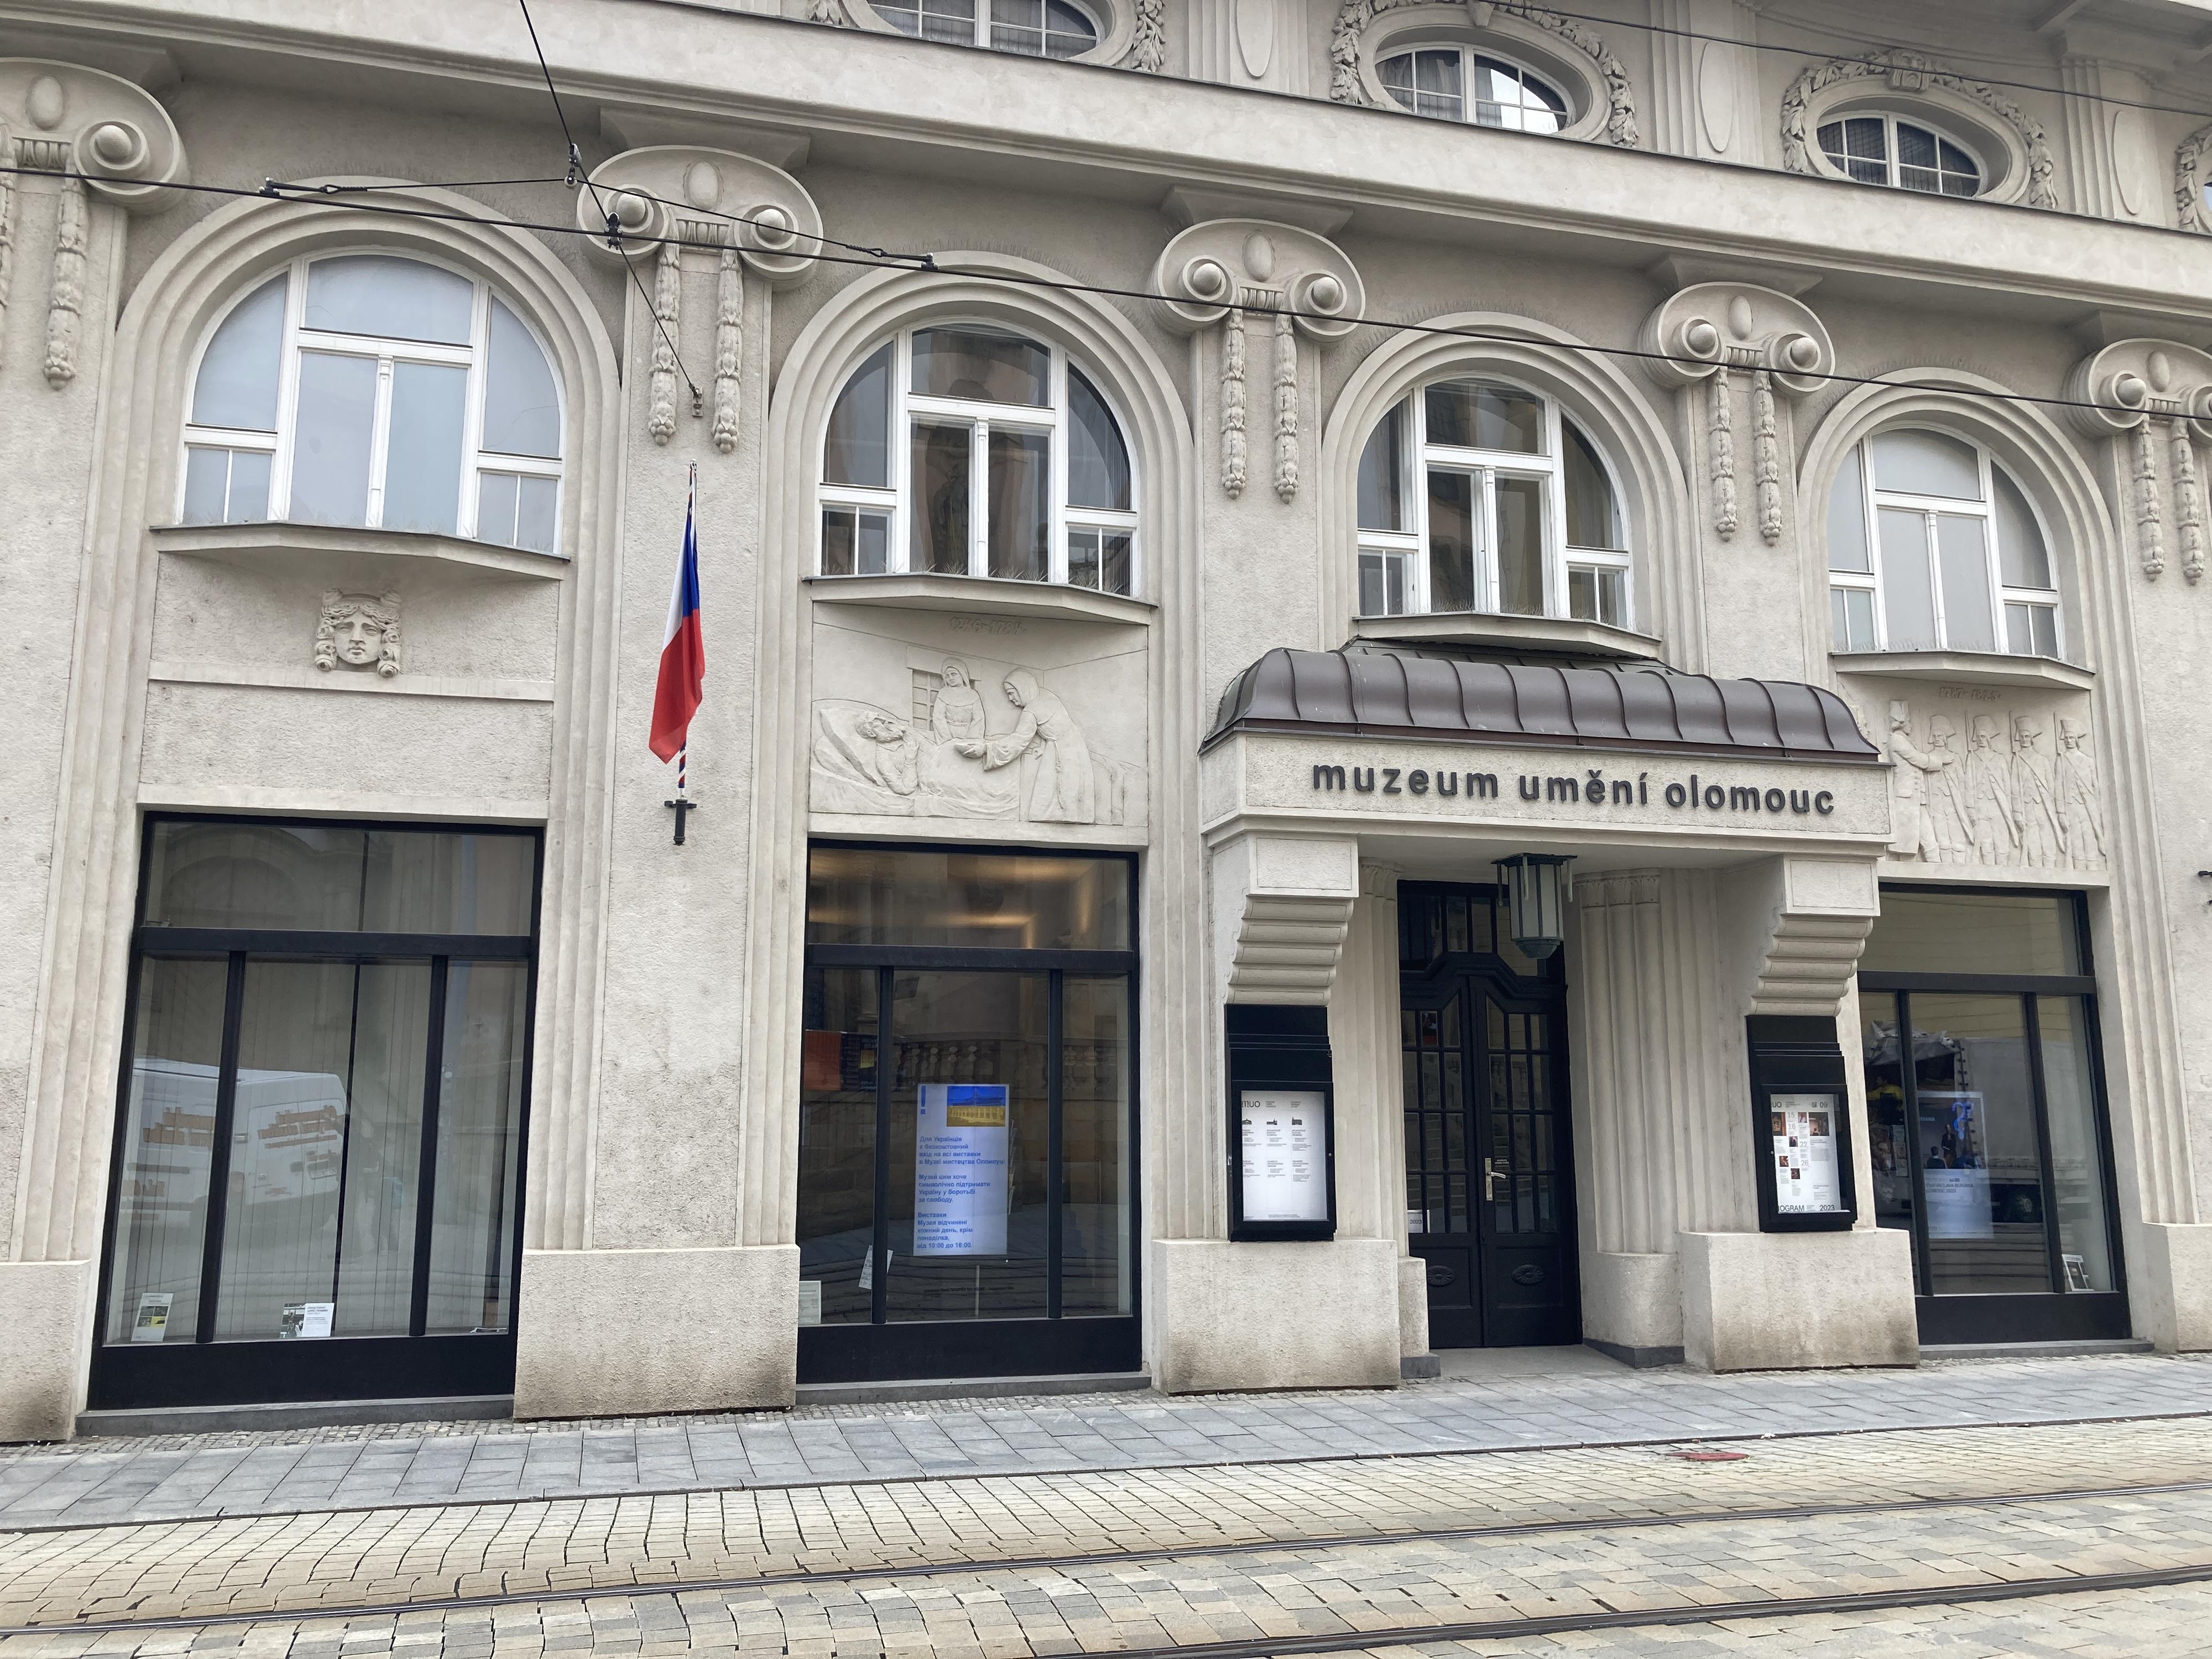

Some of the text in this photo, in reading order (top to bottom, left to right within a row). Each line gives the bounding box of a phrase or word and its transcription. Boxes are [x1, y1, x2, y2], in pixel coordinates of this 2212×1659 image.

[1313, 765, 1834, 815] muzeum umění olomouc
